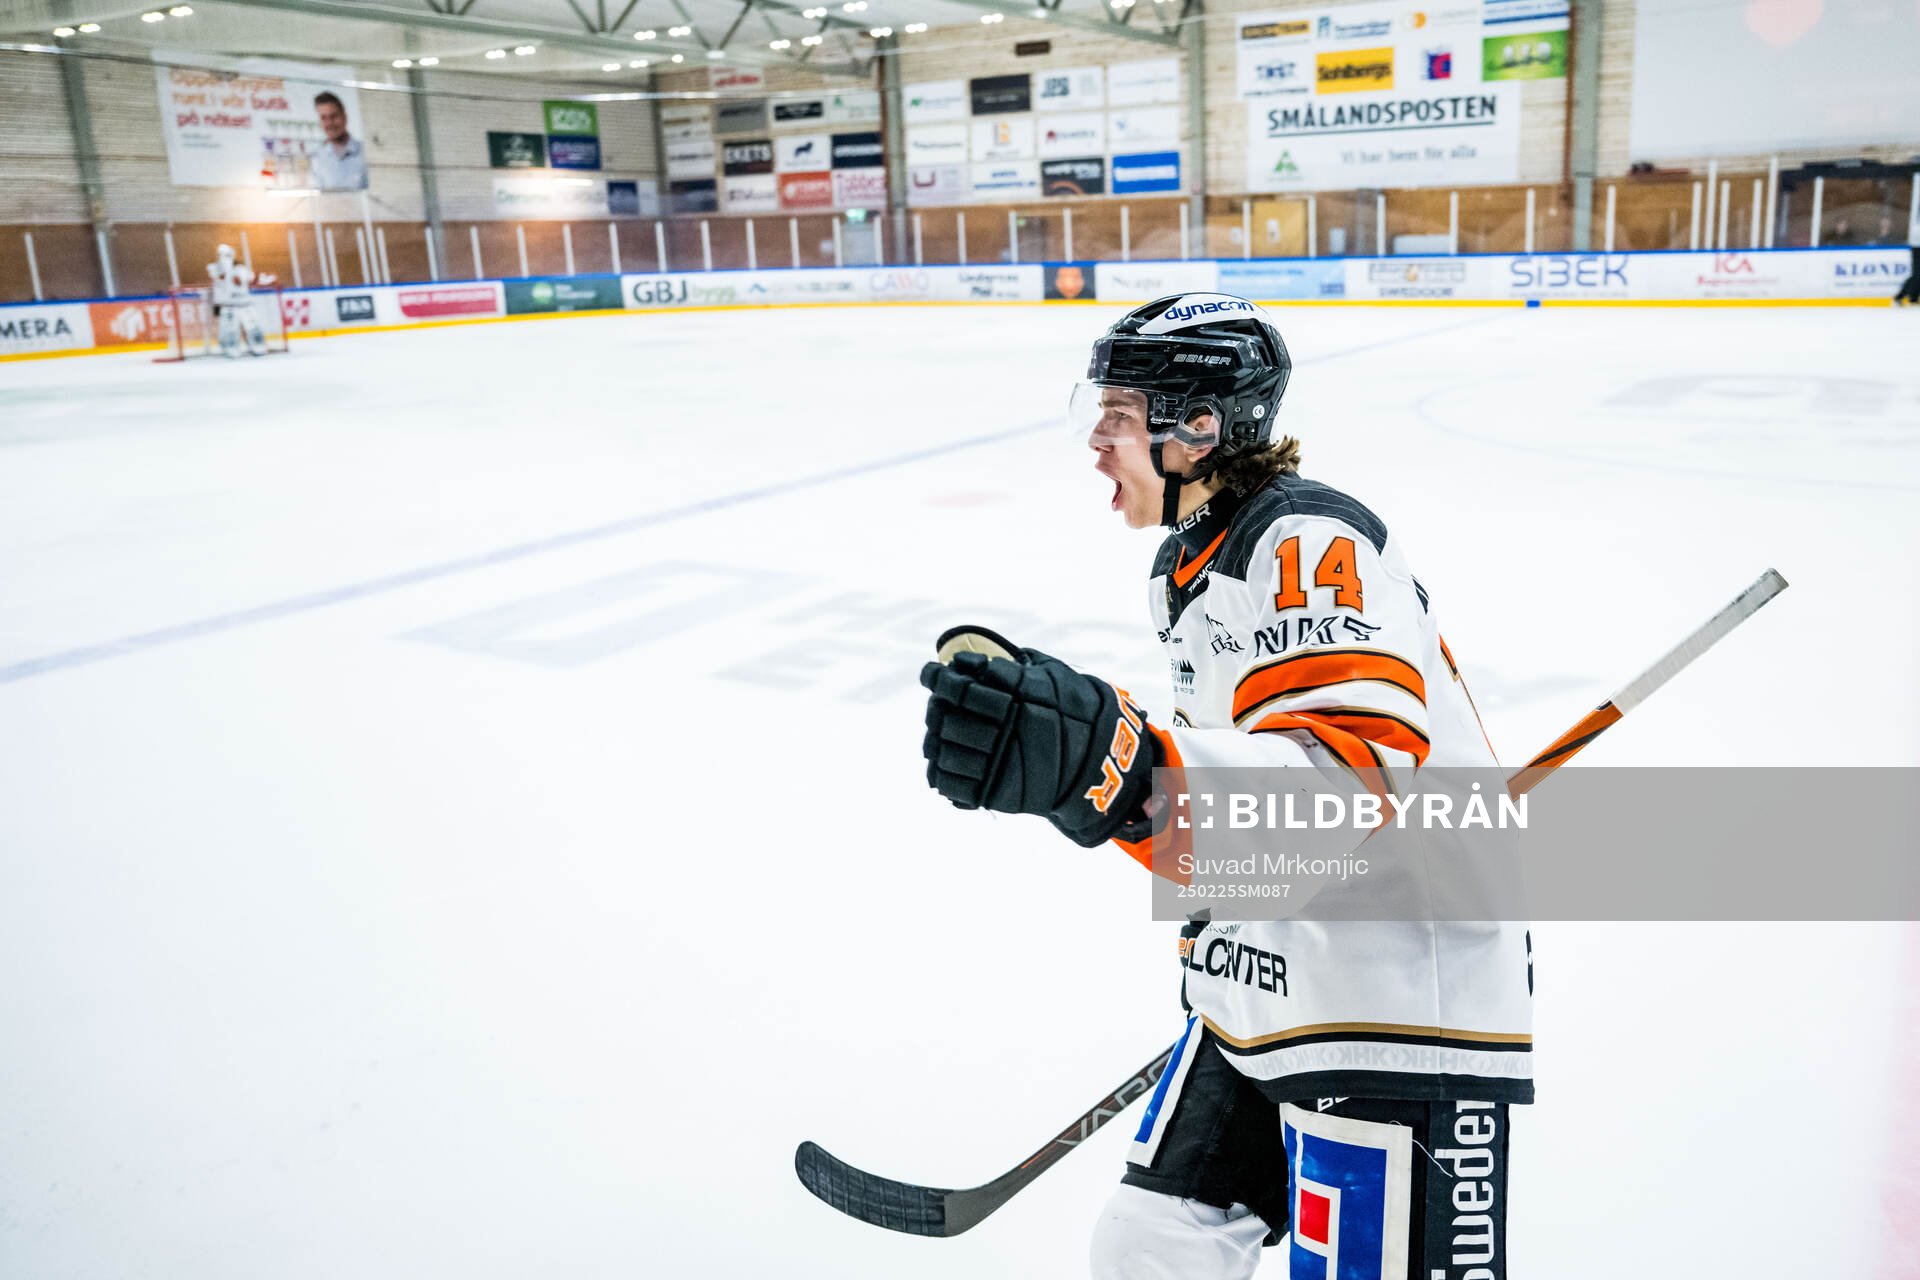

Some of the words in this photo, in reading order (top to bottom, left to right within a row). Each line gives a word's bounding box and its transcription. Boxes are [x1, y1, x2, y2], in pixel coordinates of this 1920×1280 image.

[1268, 96, 1497, 131] SMÅLANDSPOSTEN
[1714, 253, 1754, 274] ICA
[633, 281, 687, 304] GBJ
[1164, 301, 1254, 321] dynacon
[1173, 353, 1232, 366] BAUER
[1168, 503, 1211, 535] UER
[1274, 536, 1363, 614] 14
